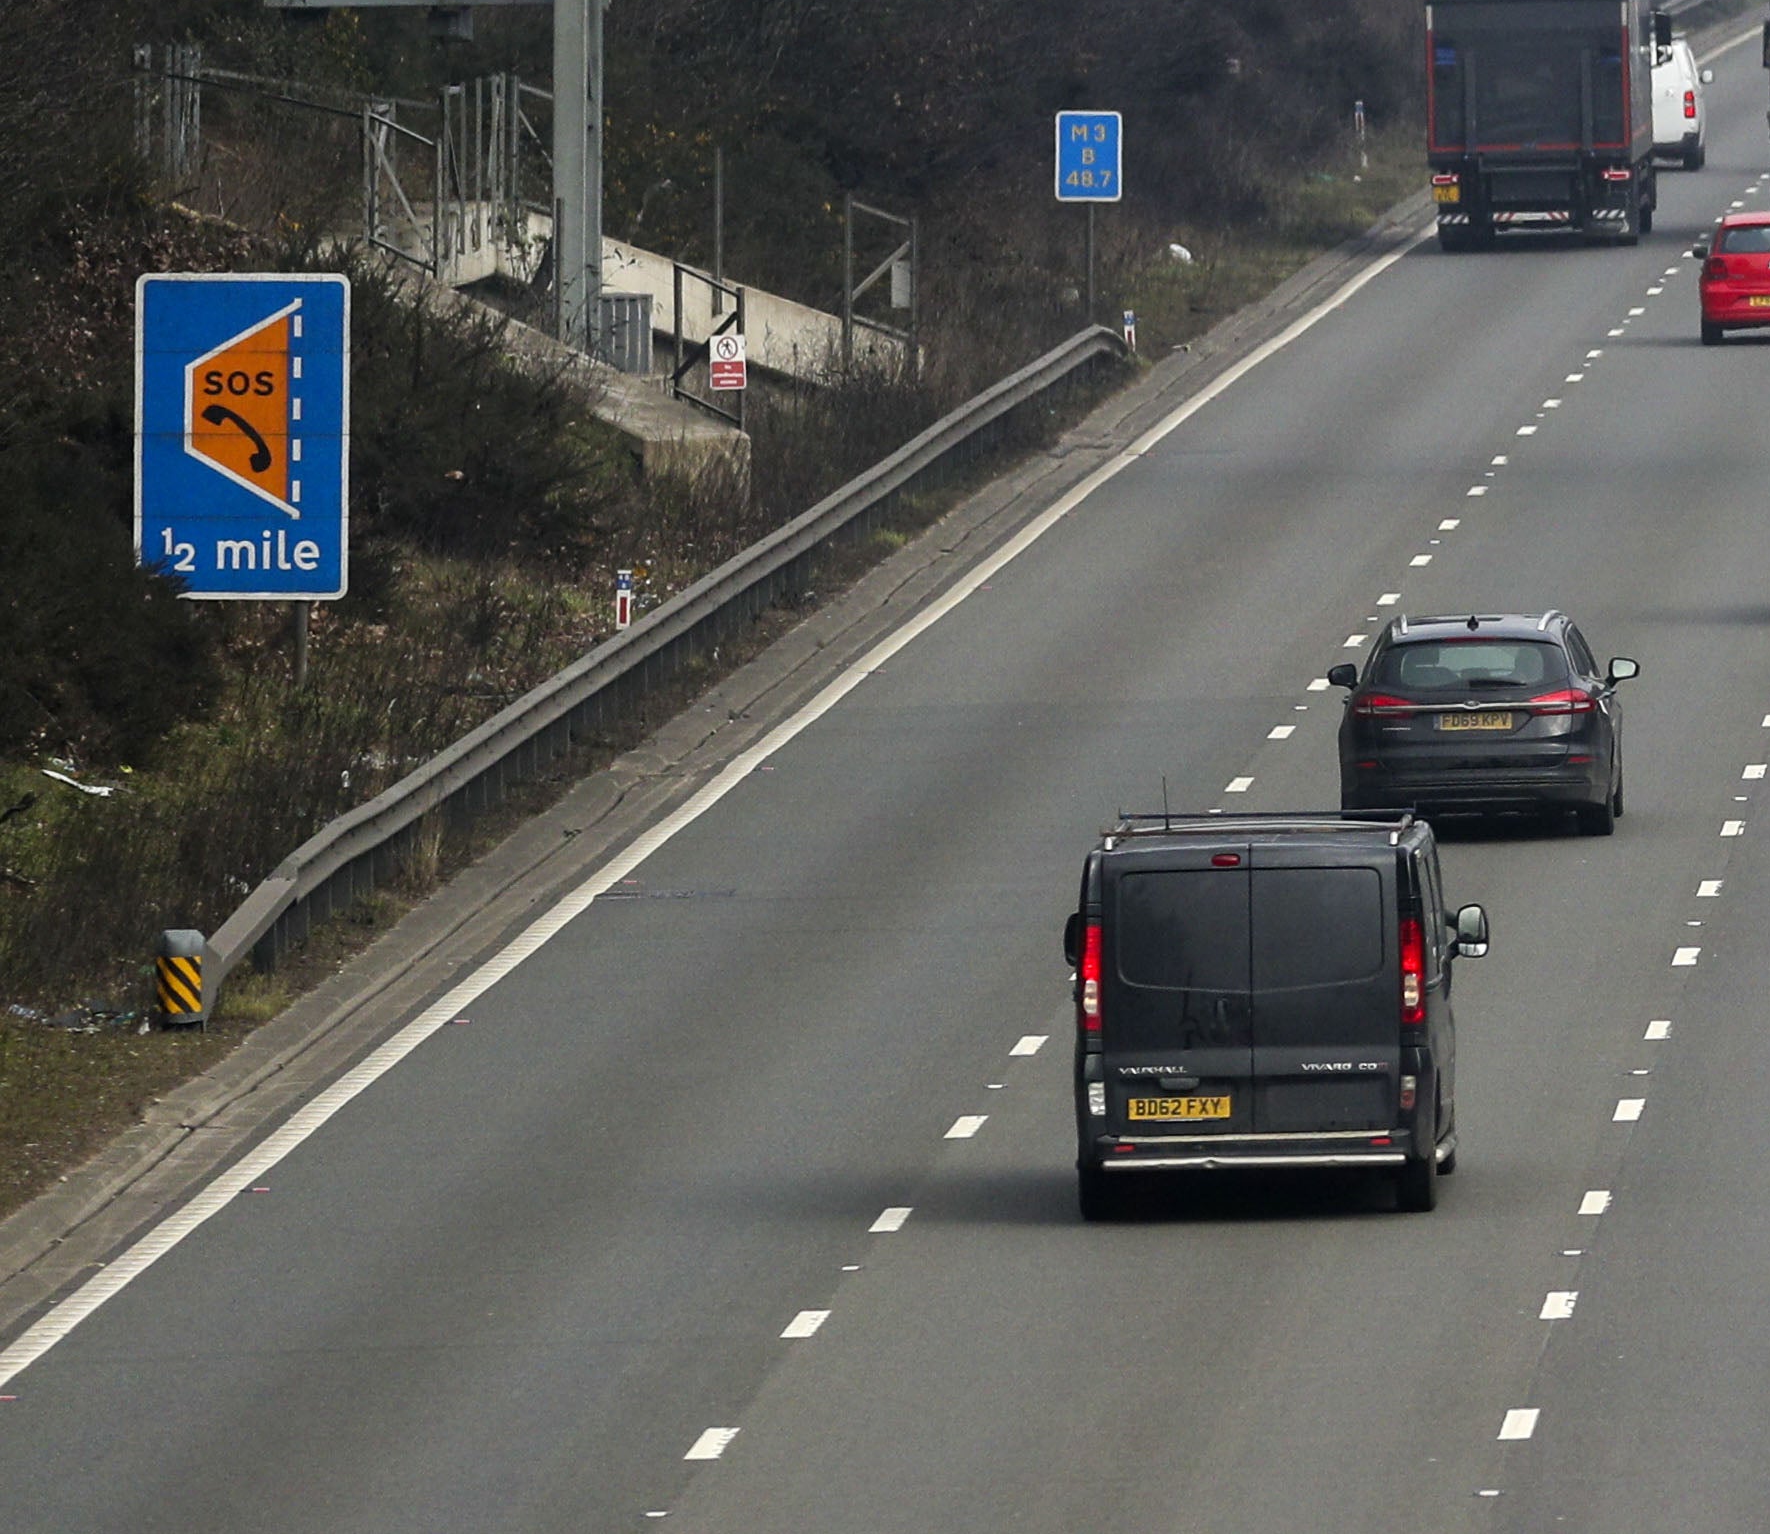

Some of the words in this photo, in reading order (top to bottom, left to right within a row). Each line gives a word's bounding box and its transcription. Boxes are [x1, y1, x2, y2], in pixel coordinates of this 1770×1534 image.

[1082, 148, 1096, 165] B
[1066, 170, 1112, 188] 48.7
[203, 371, 274, 396] SOS
[216, 529, 320, 571] mile
[1442, 714, 1479, 727] FD69
[1481, 713, 1509, 726] KPV
[1119, 1066, 1188, 1075] VAUXHALL
[1301, 1062, 1352, 1071] VIVARO
[1135, 1098, 1182, 1116] BD62
[1186, 1098, 1221, 1115] FXY
